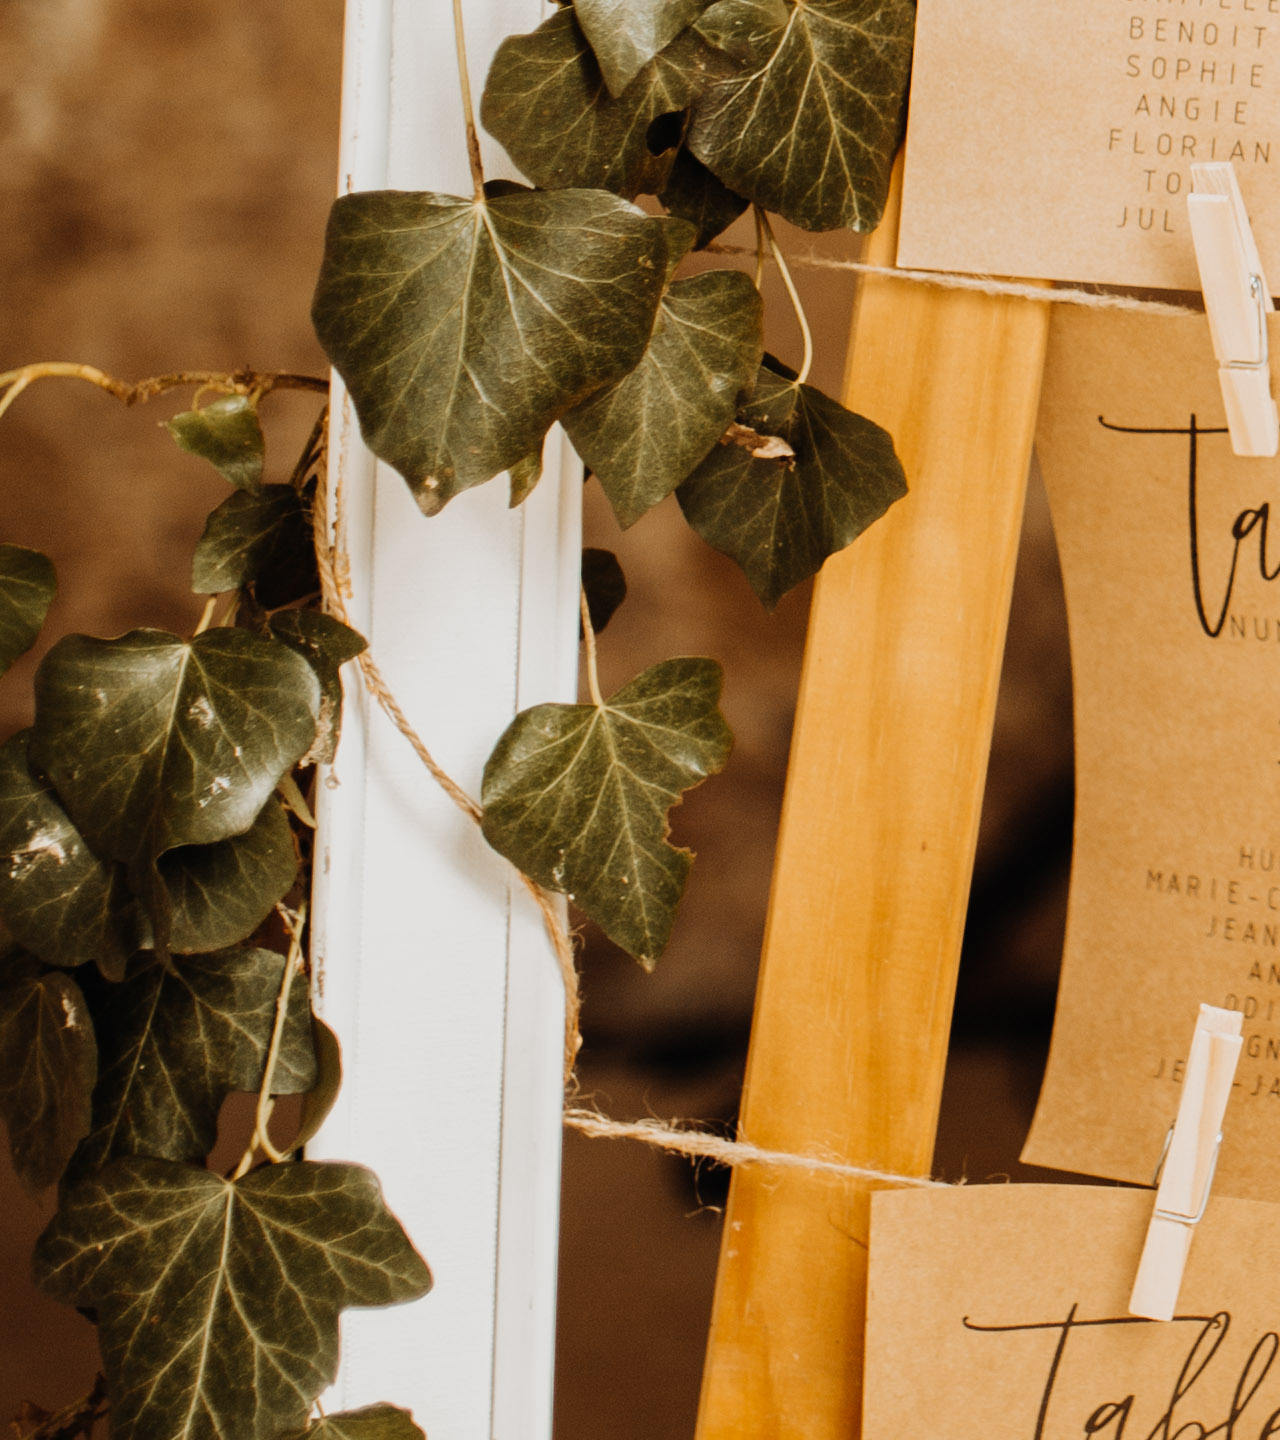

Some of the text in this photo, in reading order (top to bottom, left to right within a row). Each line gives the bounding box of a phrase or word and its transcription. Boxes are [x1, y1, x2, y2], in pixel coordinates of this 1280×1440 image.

[1129, 16, 1267, 48] BENOIT
[1126, 54, 1264, 88] SOPHIE
[1134, 94, 1247, 125] ANGIE
[1108, 127, 1271, 164] FLORIAN
